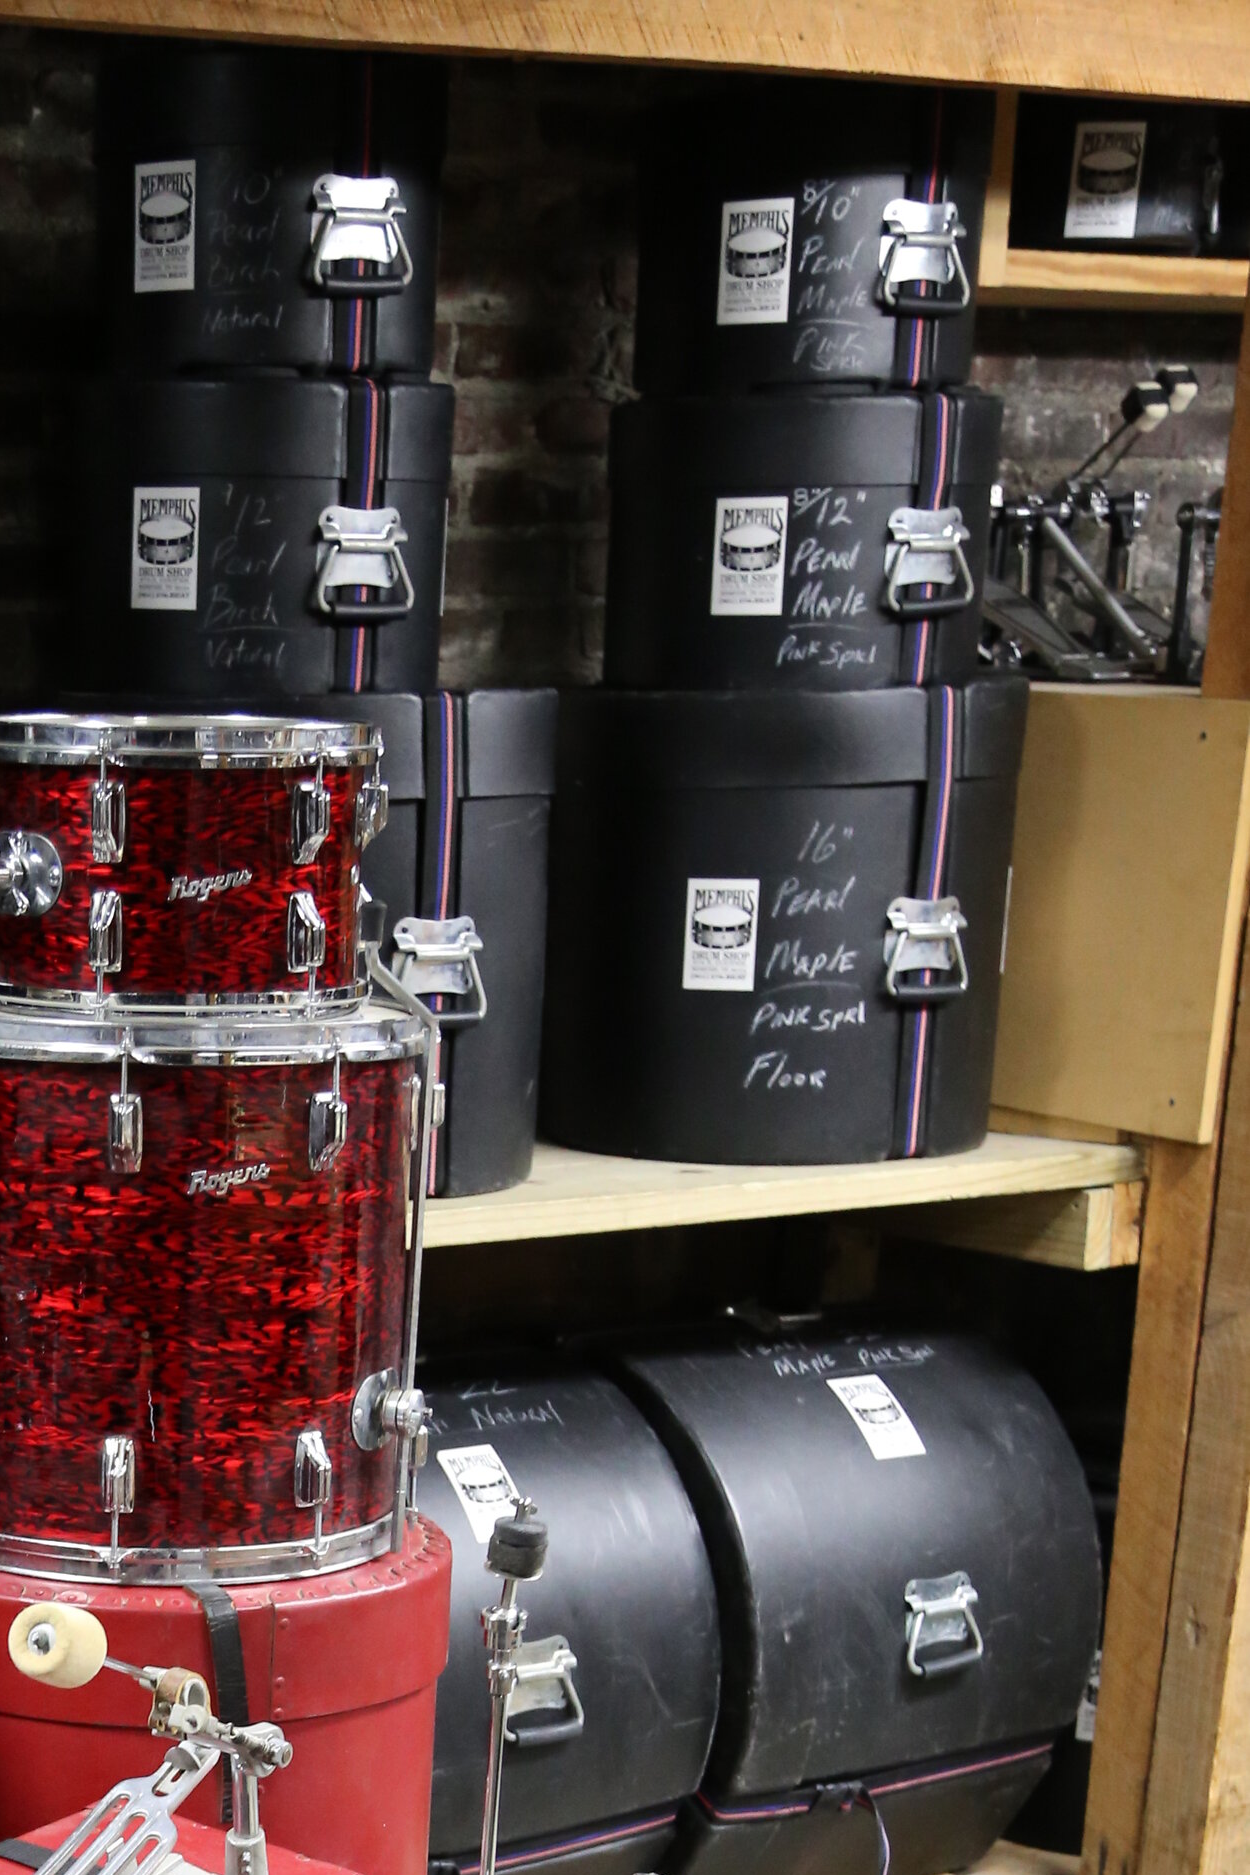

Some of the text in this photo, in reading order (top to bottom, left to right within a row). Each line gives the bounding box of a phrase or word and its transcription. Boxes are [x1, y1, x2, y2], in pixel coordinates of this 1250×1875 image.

[140, 172, 193, 201] MEMPHIS
[729, 209, 790, 238] MEMPHIS
[139, 498, 197, 525] MEMPHIS
[723, 507, 784, 533] MEMPHIS
[138, 567, 193, 577] DRUM SHOP
[167, 868, 253, 902] Rogers
[694, 889, 756, 913] MEMPHIS
[187, 1163, 271, 1196] Rogers
[446, 1453, 501, 1477] MEMPHIS
